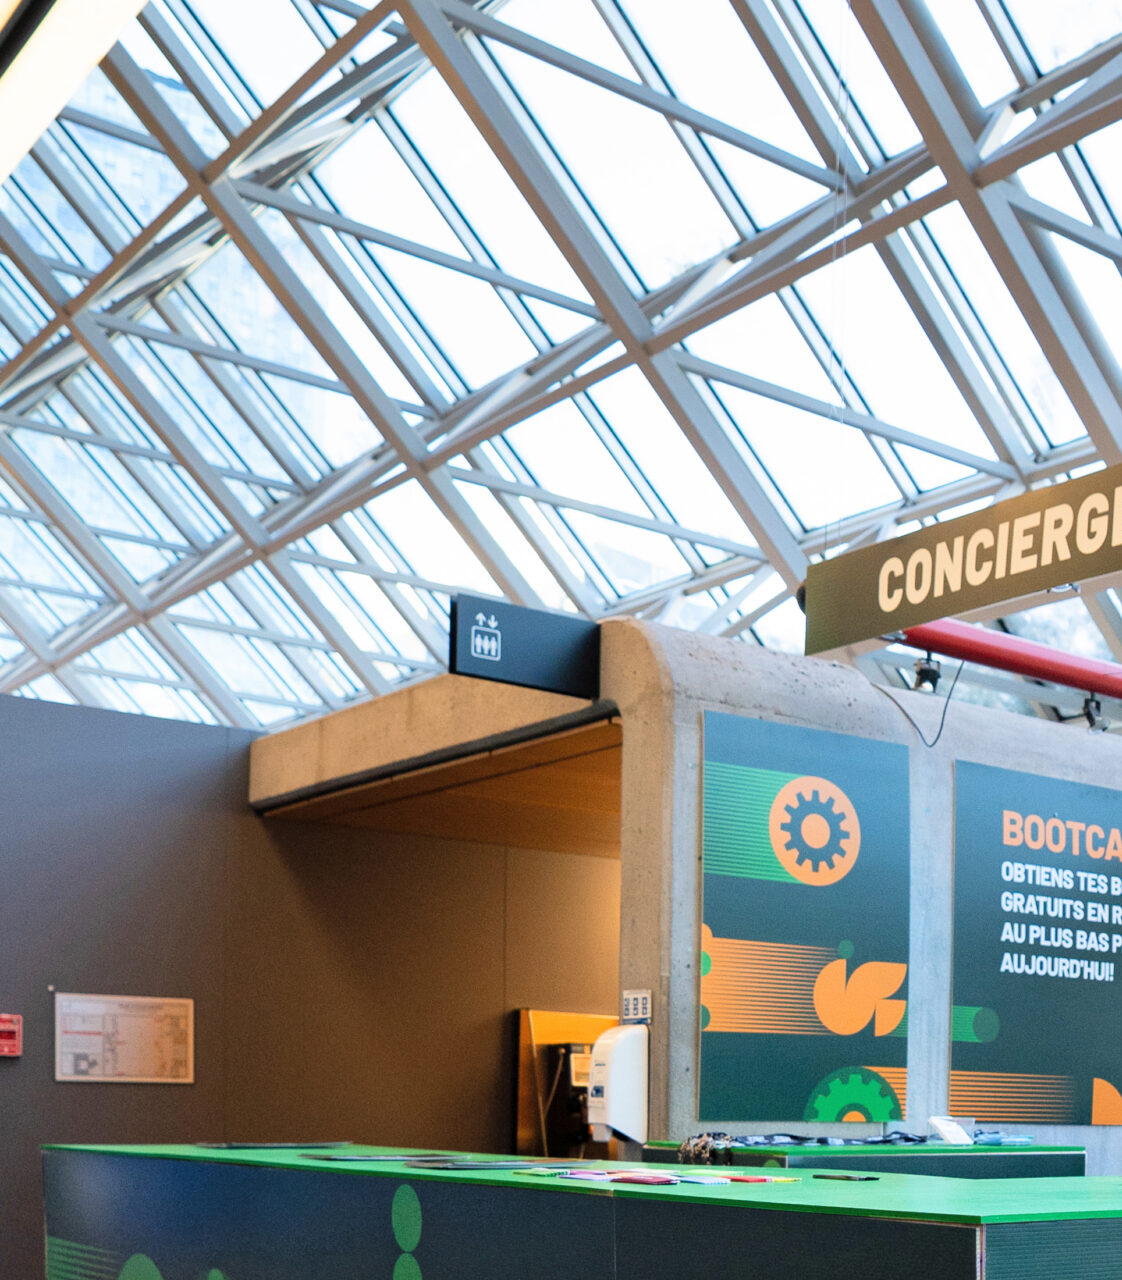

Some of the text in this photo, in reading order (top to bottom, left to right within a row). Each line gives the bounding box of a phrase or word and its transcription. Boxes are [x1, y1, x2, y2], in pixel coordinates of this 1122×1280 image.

[1001, 861, 1074, 890] OBTIENS
[1076, 871, 1109, 895] TES
[1001, 891, 1085, 921] GRATUITS
[1087, 902, 1110, 924] EN
[1001, 921, 1026, 944] AU
[1029, 925, 1073, 949] PLUS
[1076, 930, 1110, 953] BAS
[1000, 952, 1115, 983] AUJOURD'HUI!
